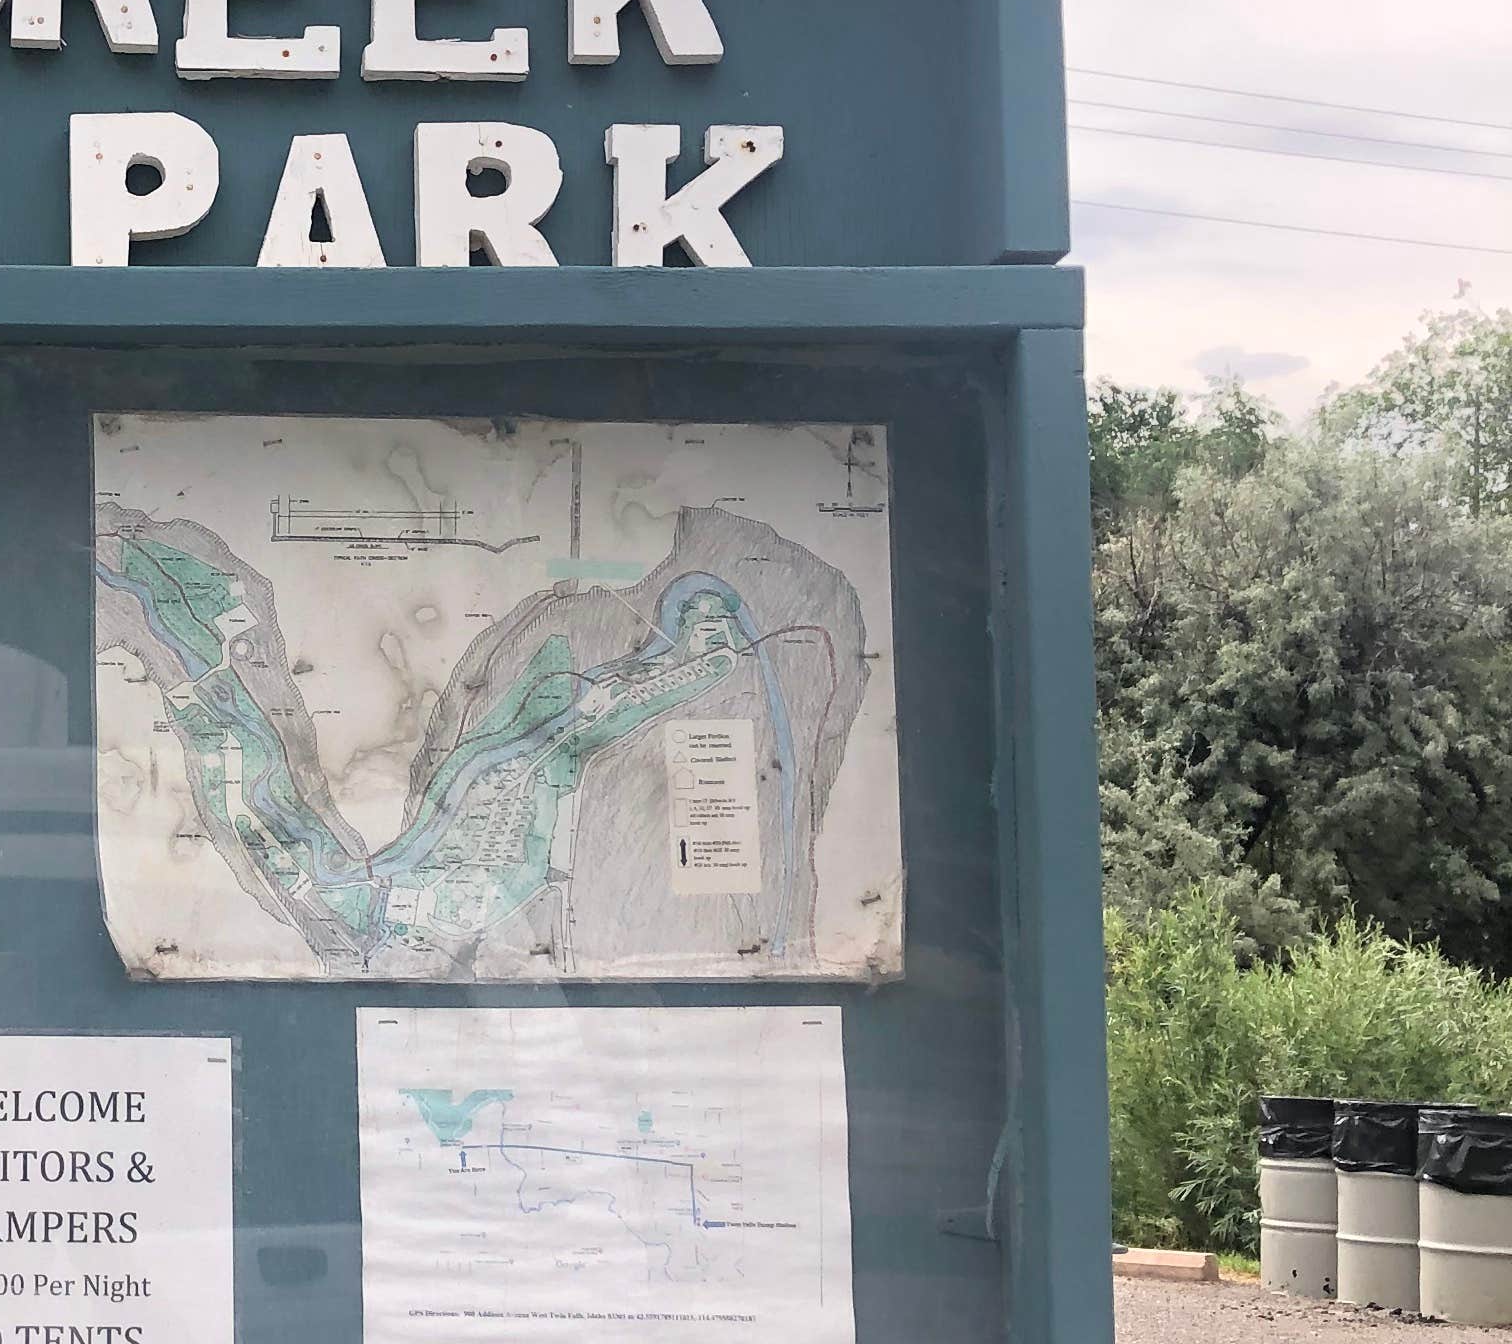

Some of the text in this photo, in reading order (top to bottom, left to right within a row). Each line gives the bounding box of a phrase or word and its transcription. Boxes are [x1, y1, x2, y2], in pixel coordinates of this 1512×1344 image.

[68, 111, 784, 268] PARK
[127, 1151, 156, 1183] &
[33, 1274, 75, 1296] Per
[83, 1274, 152, 1303] Night
